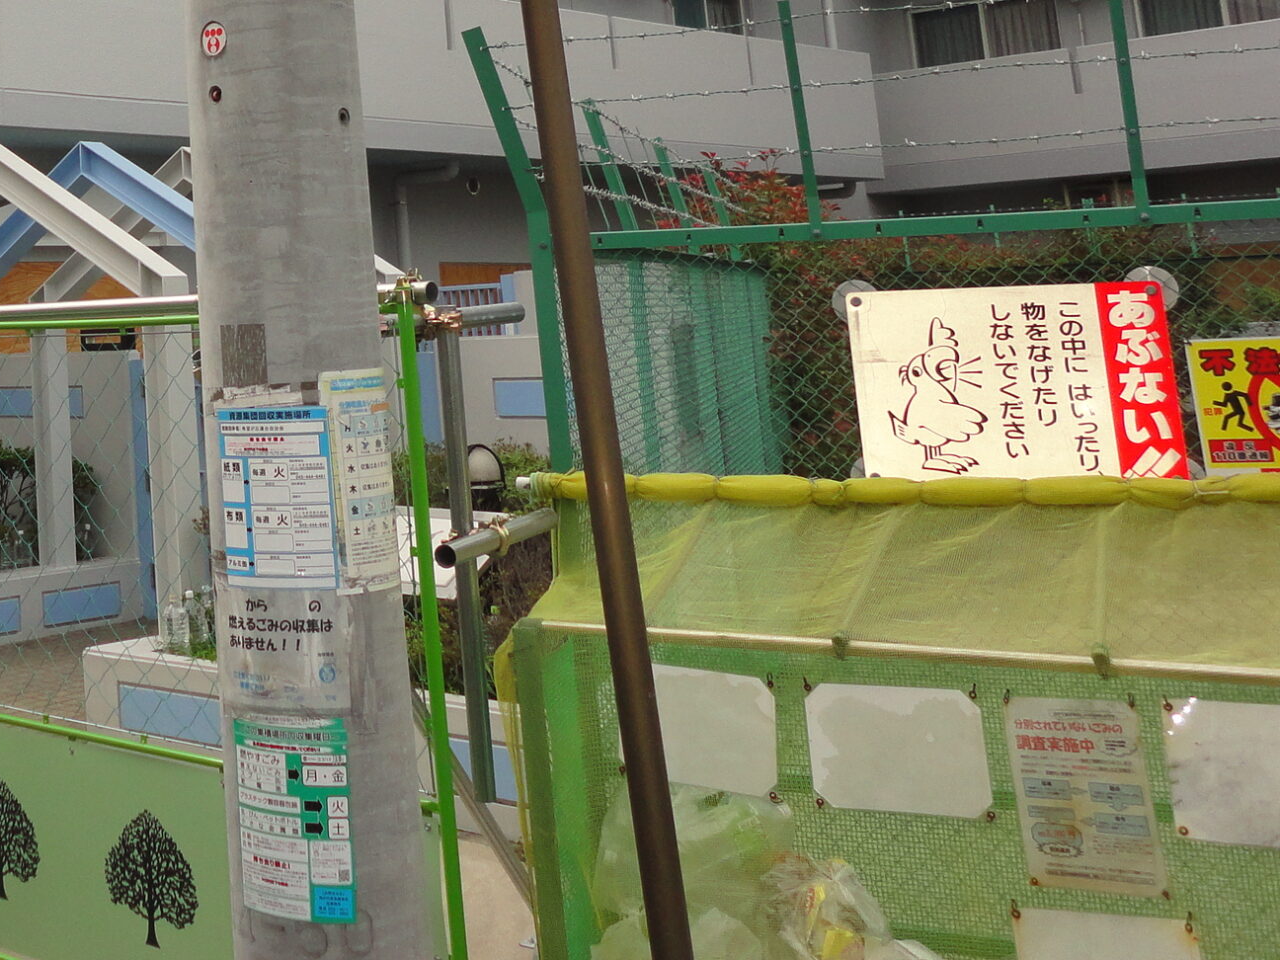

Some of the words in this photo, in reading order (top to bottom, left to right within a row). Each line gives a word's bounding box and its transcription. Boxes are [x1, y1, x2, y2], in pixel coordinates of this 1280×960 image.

[1020, 302, 1058, 426] 物をなげたり
[989, 304, 1030, 458] しないでください
[345, 443, 354, 453] 火
[223, 462, 240, 472] 紙類
[273, 466, 285, 478] 火
[347, 464, 355, 474] 水
[349, 485, 358, 494] 木
[226, 510, 244, 522] 布類
[276, 513, 288, 526] 火
[246, 598, 267, 612] から
[309, 600, 321, 612] の
[228, 615, 333, 633] 燃えるごみの収集は
[1016, 735, 1094, 754] 調査実施中
[305, 769, 344, 783] 月・金
[332, 799, 344, 813] 火
[332, 823, 345, 836] 土
